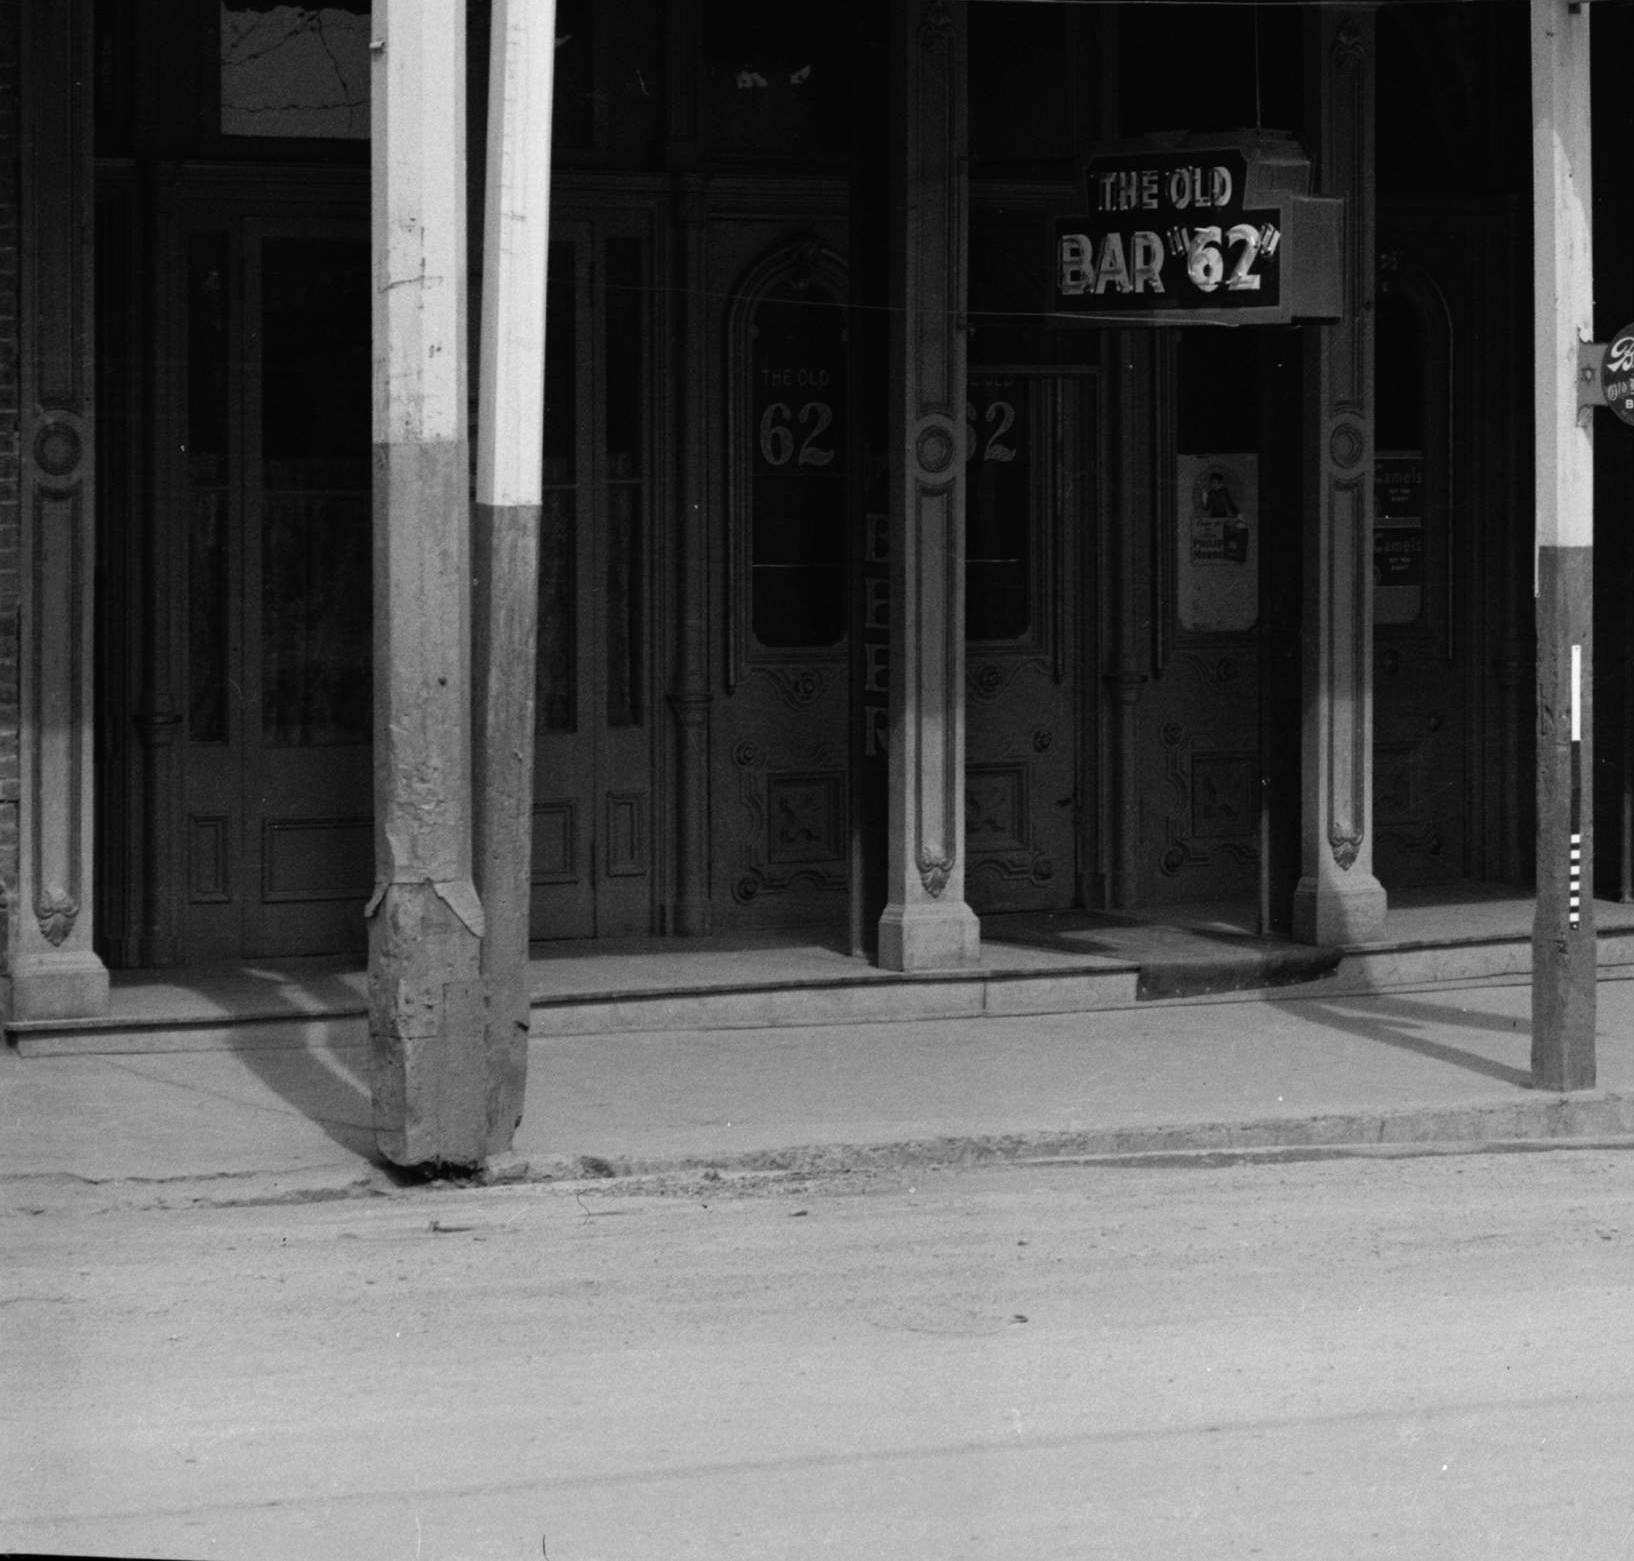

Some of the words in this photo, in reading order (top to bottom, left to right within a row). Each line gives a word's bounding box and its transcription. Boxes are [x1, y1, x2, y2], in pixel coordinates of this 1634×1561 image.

[1098, 170, 1160, 211] THE
[1167, 165, 1233, 210] OLD
[1057, 231, 1166, 296] BAR
[760, 368, 792, 387] THE
[797, 368, 831, 387] OLD
[1607, 381, 1628, 401] Old
[759, 402, 835, 465] 62
